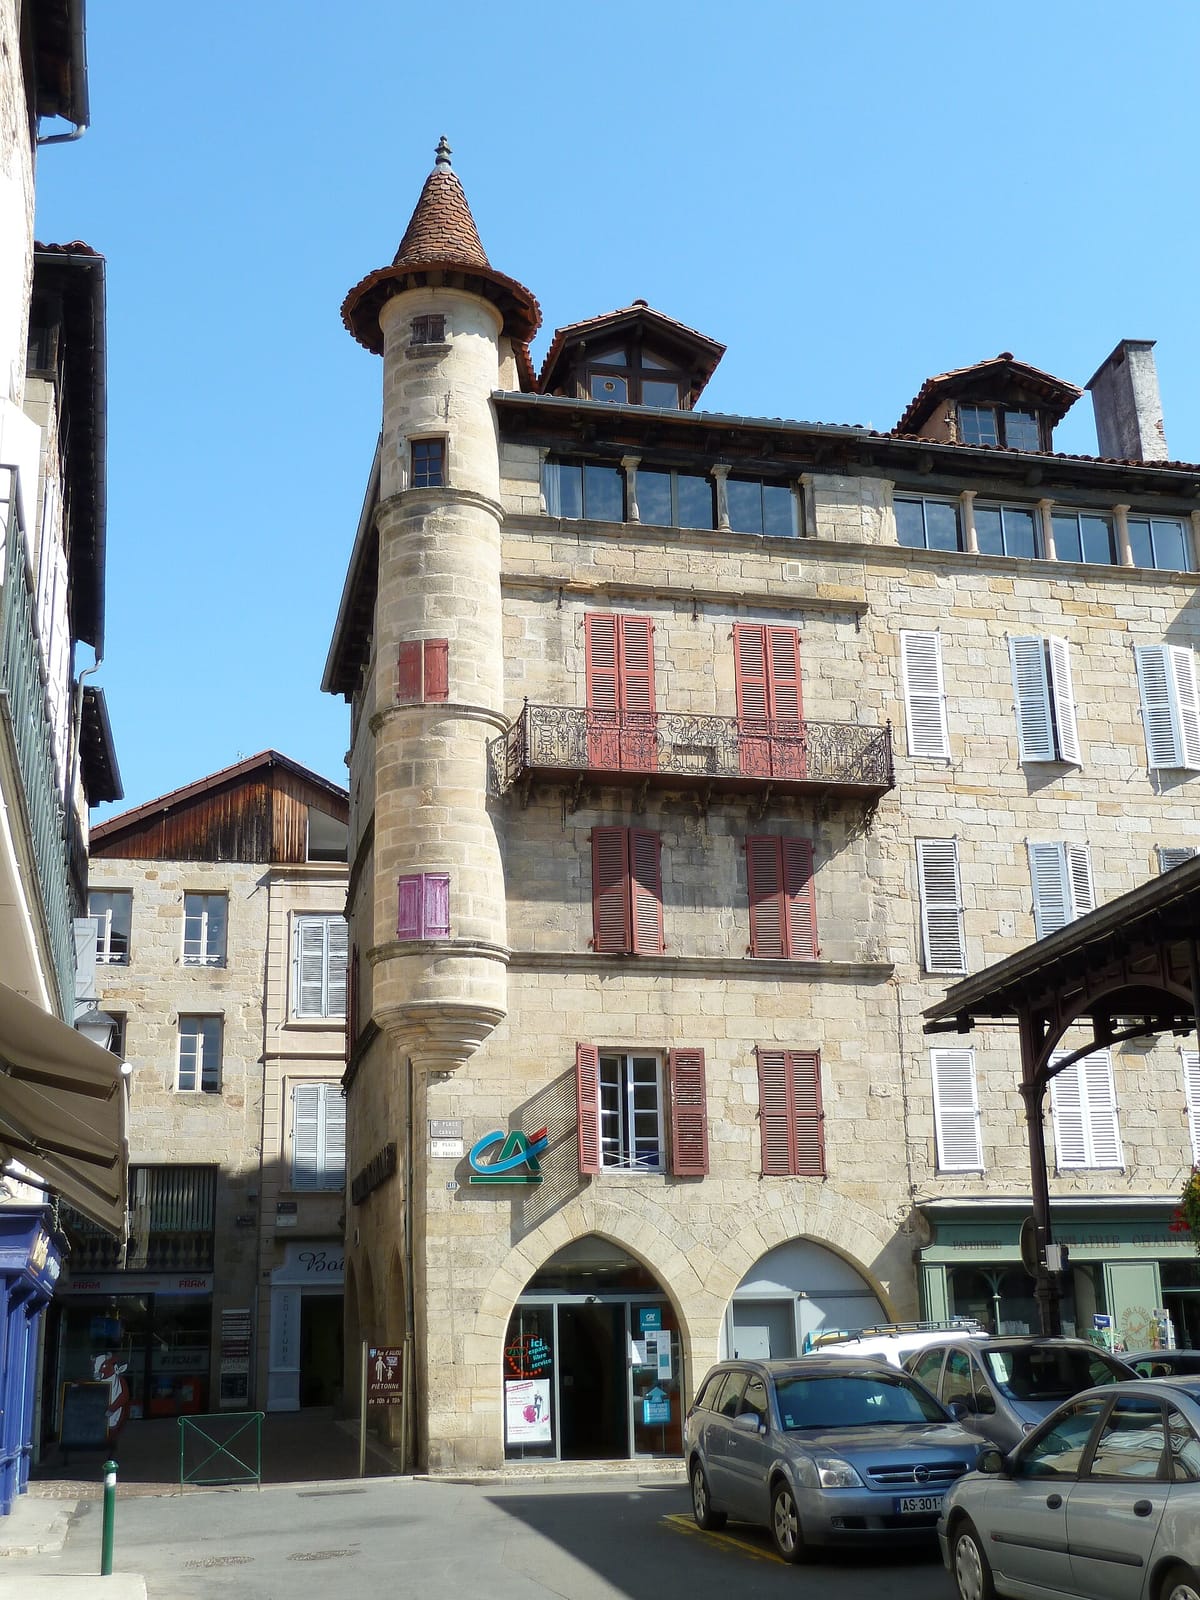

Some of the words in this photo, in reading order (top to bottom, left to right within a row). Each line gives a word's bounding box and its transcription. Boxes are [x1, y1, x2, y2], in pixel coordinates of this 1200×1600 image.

[73, 1281, 101, 1289] FRAM
[179, 1280, 206, 1288] FRAM
[531, 1338, 543, 1347] ici
[903, 1497, 943, 1511] AS-301-
